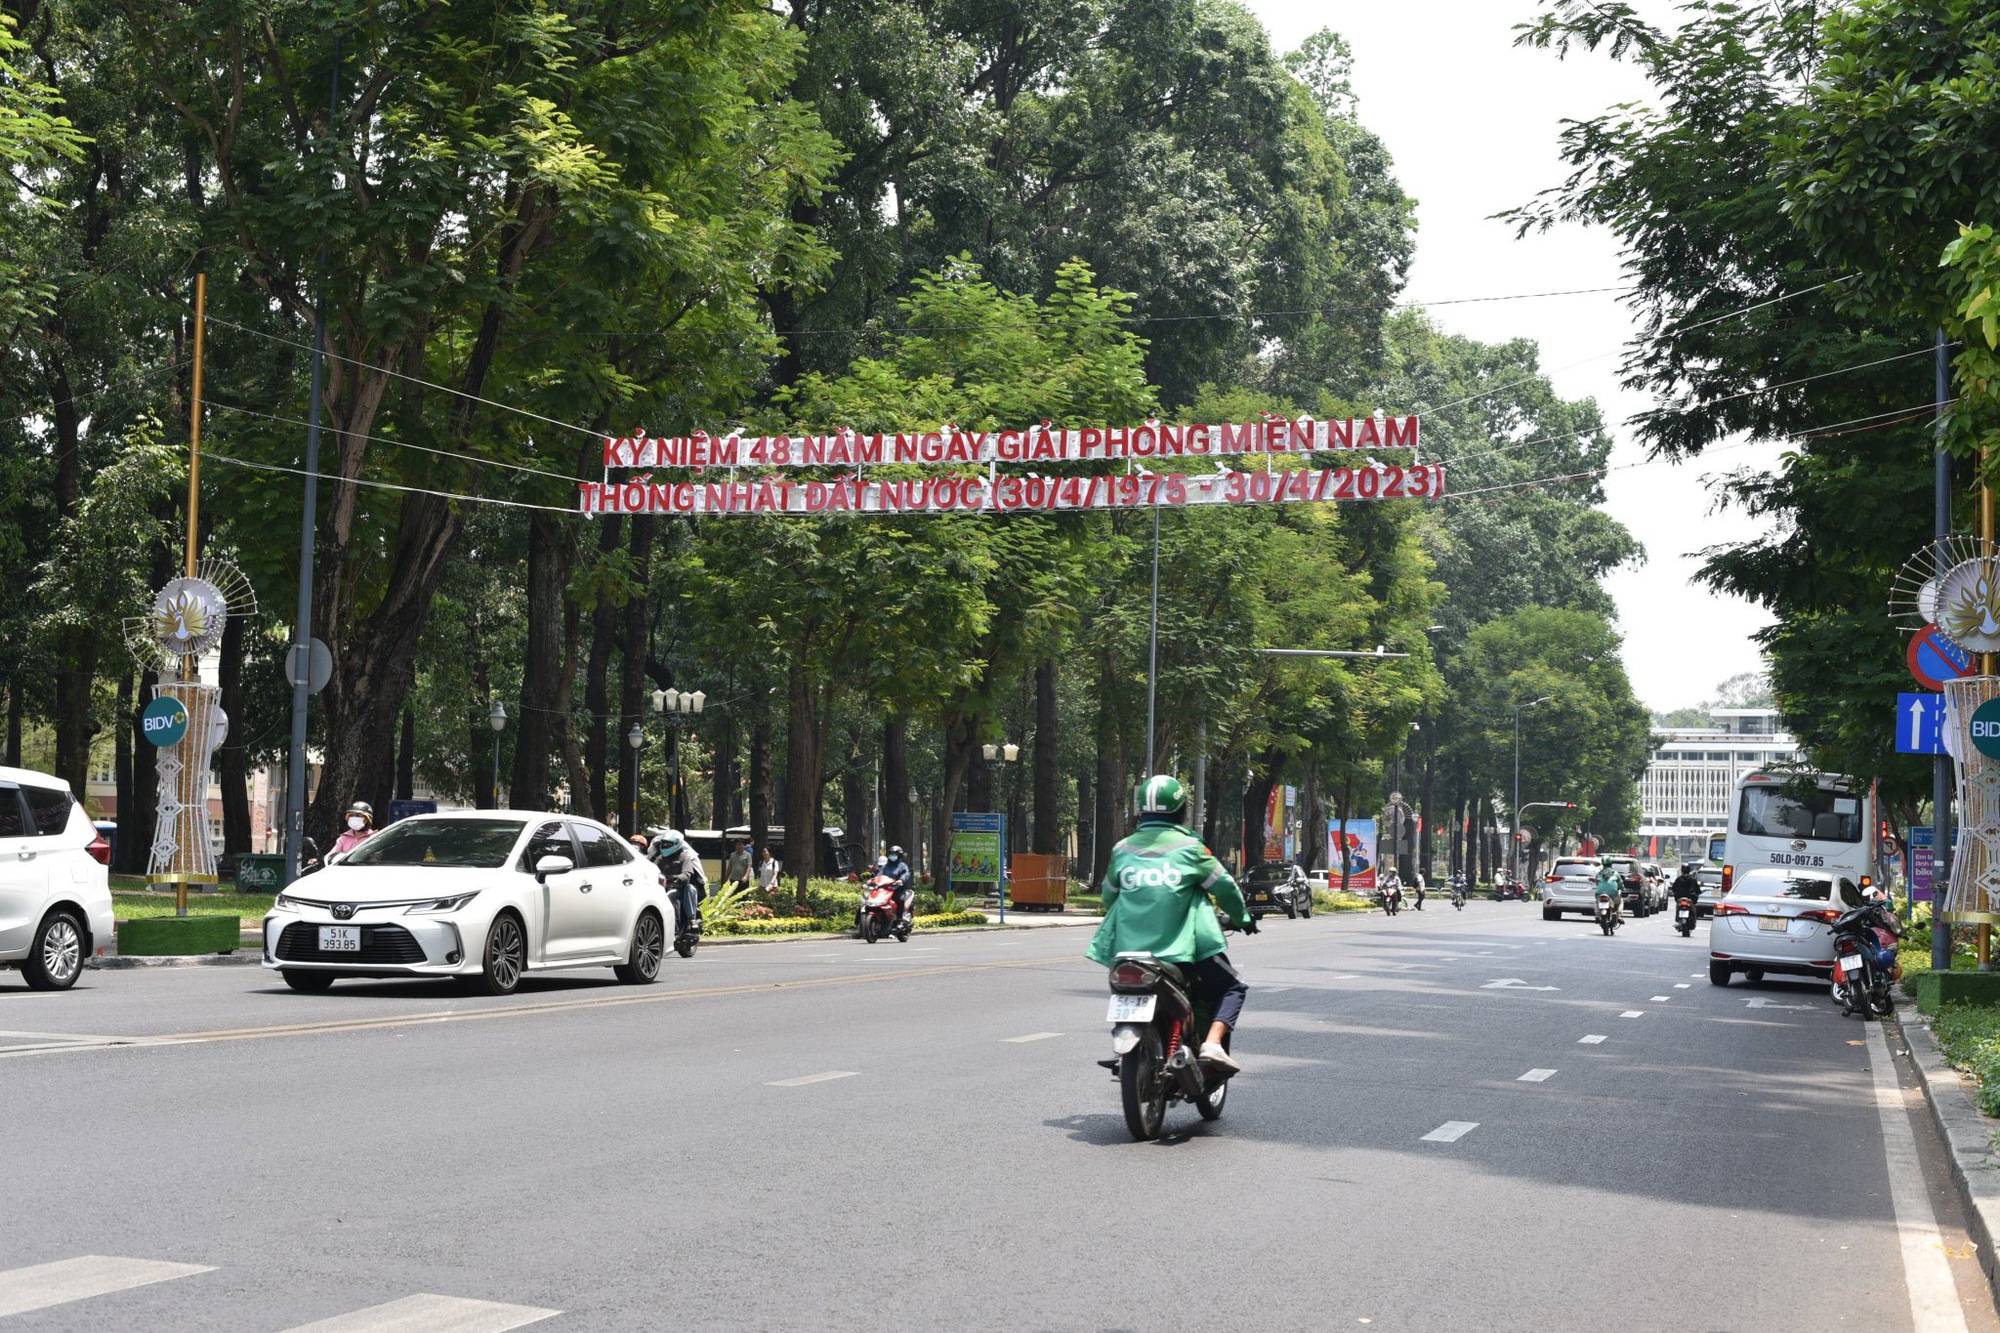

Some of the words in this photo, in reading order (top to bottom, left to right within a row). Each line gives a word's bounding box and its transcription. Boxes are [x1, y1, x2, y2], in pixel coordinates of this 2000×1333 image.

[602, 427, 649, 466] KỶ
[656, 429, 740, 474] NIỆM
[750, 435, 792, 464] 48
[802, 425, 884, 464] NĂM
[894, 424, 990, 462] NGÀY
[1000, 419, 1068, 460] GIẢI
[1079, 418, 1210, 458] PHÓNG
[1220, 410, 1315, 453] MIỀN
[1327, 415, 1419, 449] NAM
[579, 472, 696, 512] THỐNG
[705, 473, 797, 512] NHẤT
[805, 472, 870, 511] ĐẤT
[880, 471, 983, 510] NƯỚC
[991, 472, 1188, 512] (30/4/1975
[1225, 461, 1445, 503] 30/4/2023)
[144, 715, 175, 731] BIDV
[1770, 852, 1824, 867] 50LD-097.85
[1120, 862, 1182, 890] Grab
[330, 928, 348, 939] 51K
[323, 939, 356, 950] 393.85
